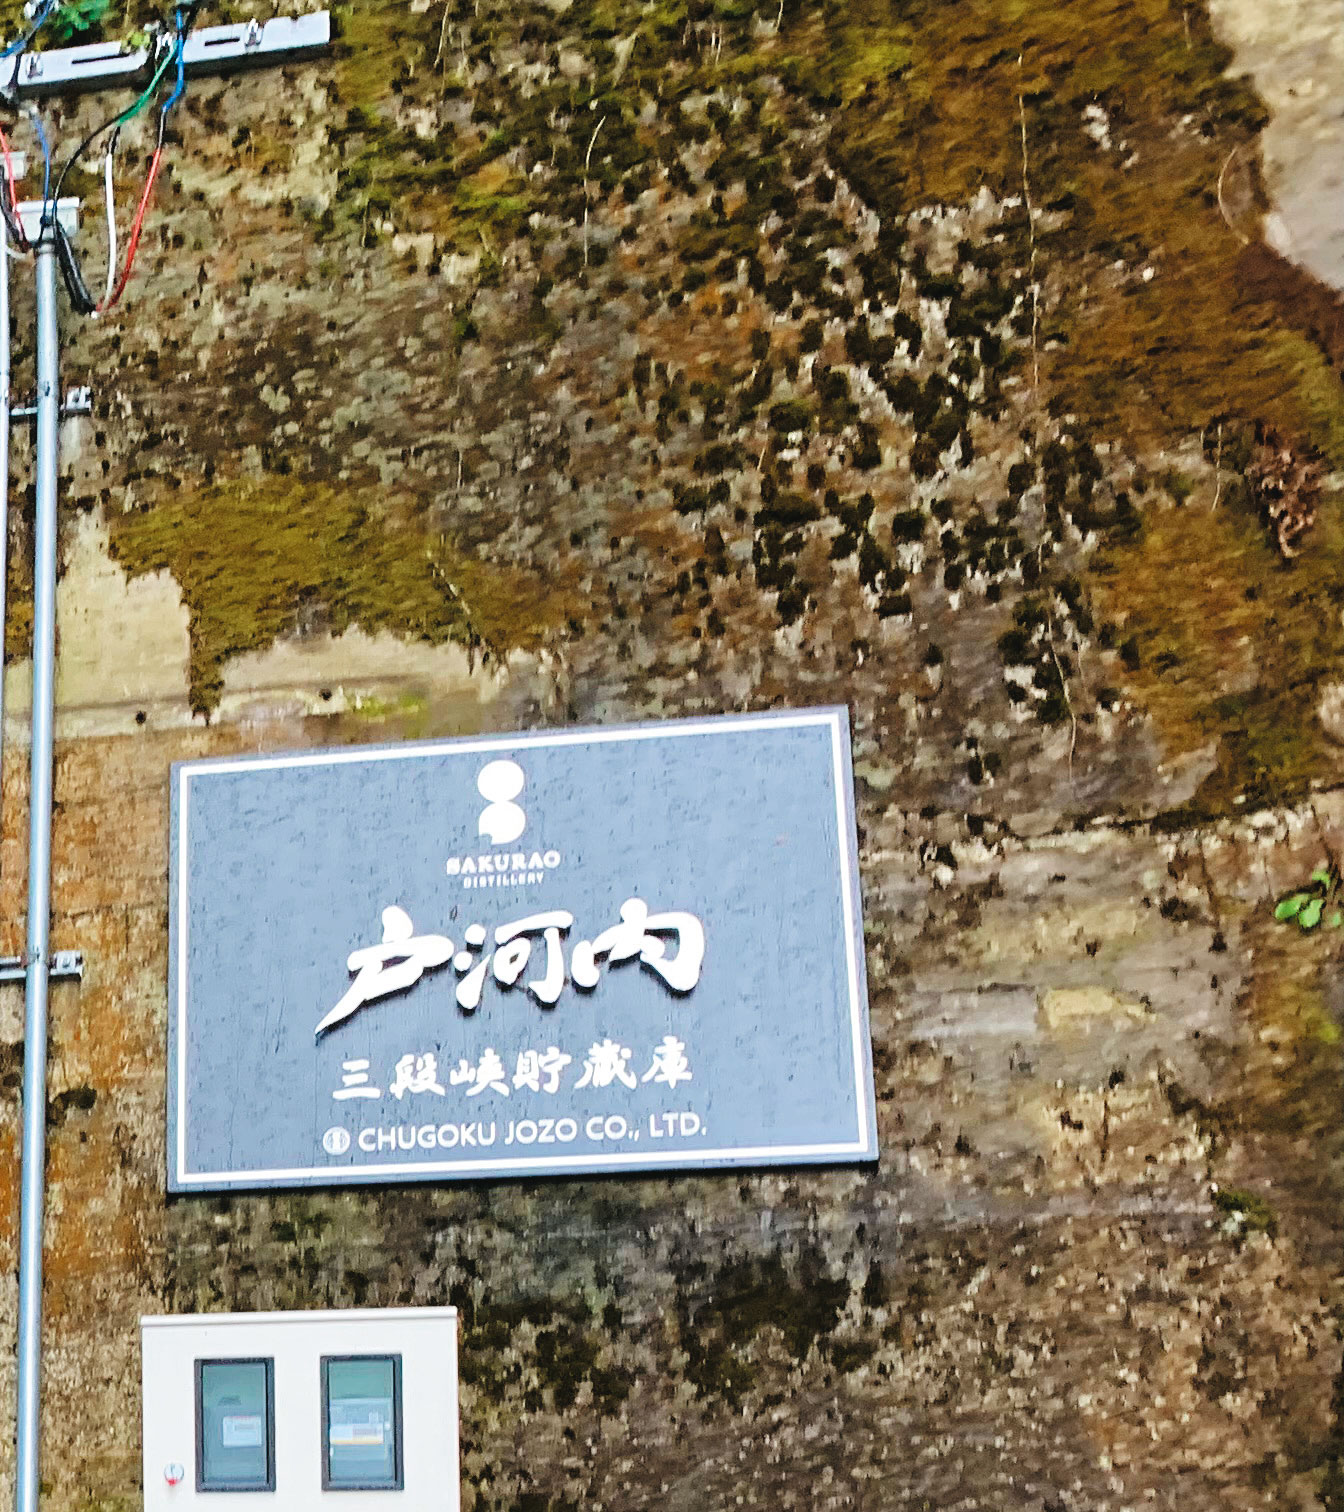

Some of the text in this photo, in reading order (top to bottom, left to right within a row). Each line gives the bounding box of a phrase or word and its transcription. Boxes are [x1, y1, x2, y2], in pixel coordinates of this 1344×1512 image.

[446, 850, 561, 875] SAKURAO
[332, 1035, 693, 1100] 三段峡貯蔵庫
[358, 1111, 708, 1152] CHUGOKU JOZO CO., LTD.
